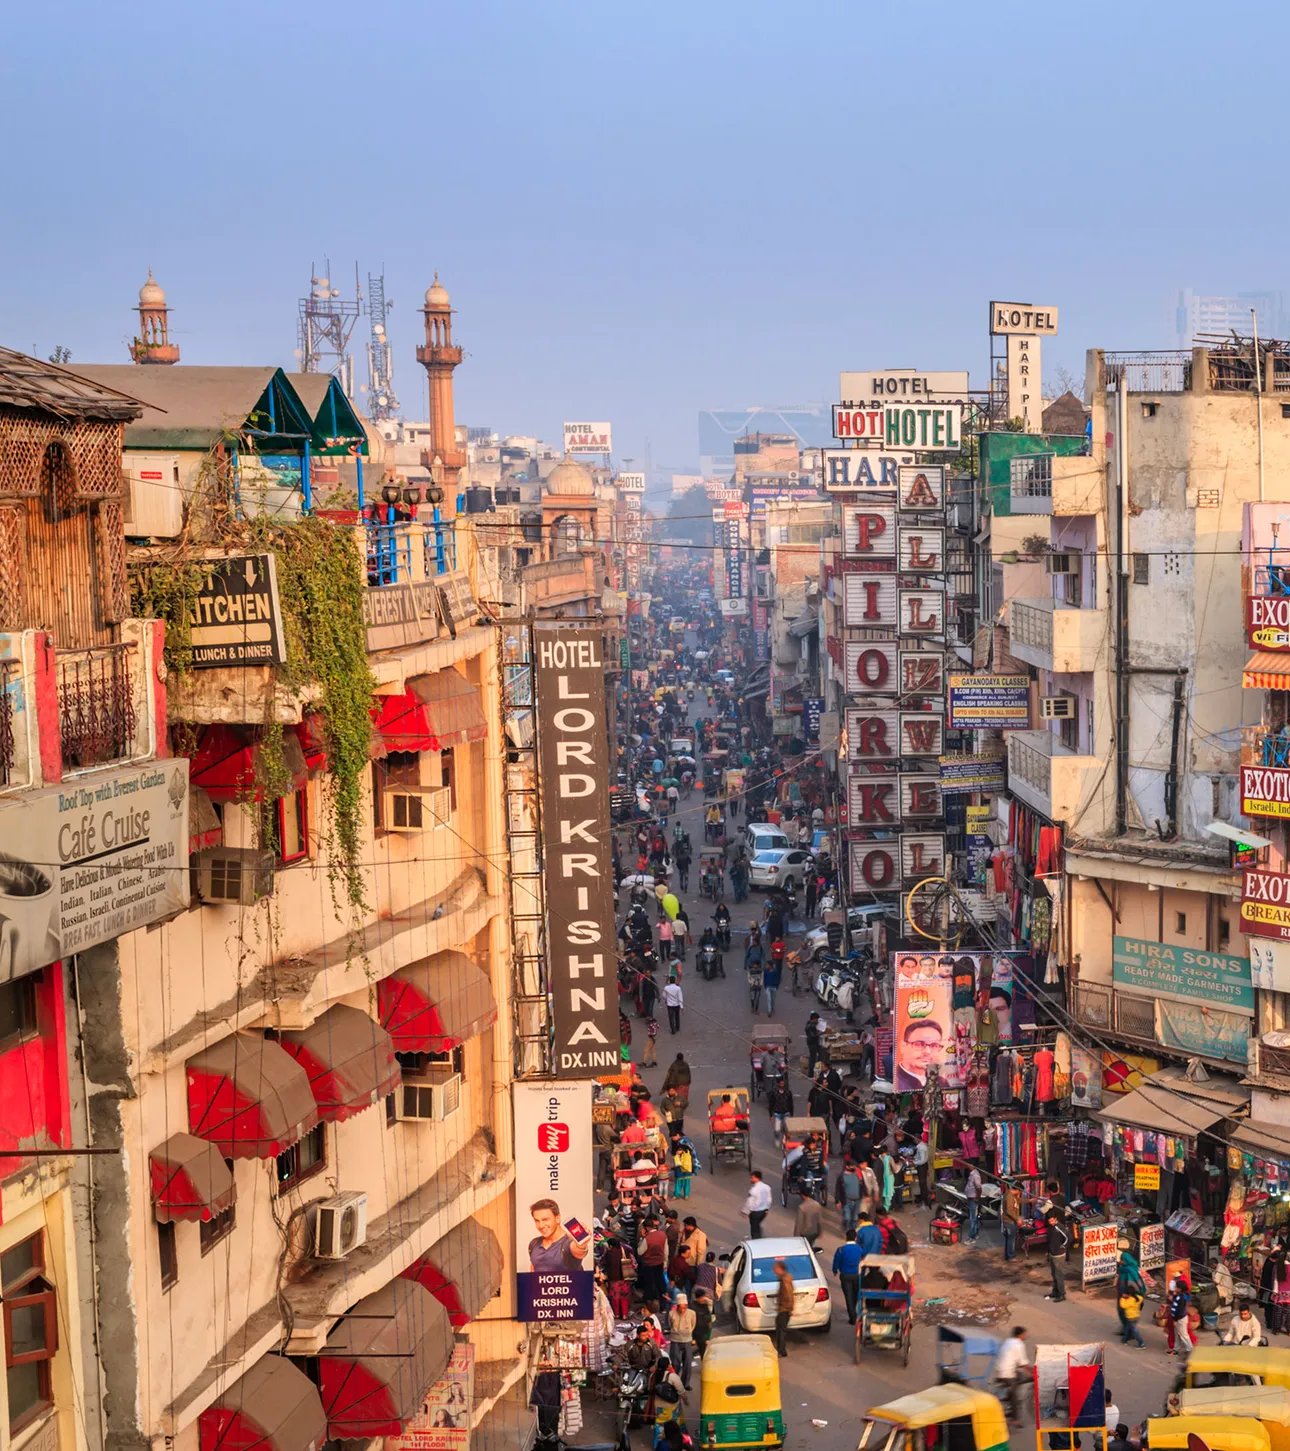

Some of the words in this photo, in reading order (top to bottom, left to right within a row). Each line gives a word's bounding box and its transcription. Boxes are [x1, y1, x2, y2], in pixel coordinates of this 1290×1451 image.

[1019, 341, 1029, 387] HARI
[873, 378, 932, 394] HOTEL
[565, 424, 594, 433] HOTEL
[569, 435, 607, 445] AMAN
[886, 409, 959, 448] HOTEL
[363, 590, 403, 625] EVEREST
[196, 648, 227, 661] LUNCH
[229, 648, 236, 658] &
[238, 645, 273, 657] DINNER
[541, 641, 601, 668] HOTEL
[1002, 678, 1028, 686] CLASSES
[553, 676, 597, 798] LORD
[58, 793, 77, 813] Roof
[79, 789, 94, 810] Top
[95, 783, 112, 803] with
[113, 777, 139, 797] Everest
[140, 770, 166, 789] Garden
[58, 814, 96, 862] Café
[101, 806, 151, 848] Cruise
[60, 876, 75, 895] Have
[111, 887, 146, 912] Continental
[146, 881, 166, 898] Cuisine
[103, 913, 125, 933] LUNCH
[133, 899, 156, 921] DINNER
[561, 820, 609, 1045] KRISHNA
[1125, 941, 1175, 961] HIRA
[1183, 952, 1242, 973] SONS
[1124, 966, 1155, 978] READY
[1158, 972, 1184, 984] MADE
[1187, 978, 1242, 995] GARMENTS
[1138, 978, 1178, 992] COMPLETE
[539, 1275, 572, 1284] HOTEL
[542, 1287, 569, 1295] LORD
[533, 1298, 578, 1307] KRISHNA
[538, 1310, 554, 1318] DX.
[557, 1309, 573, 1318] INN
